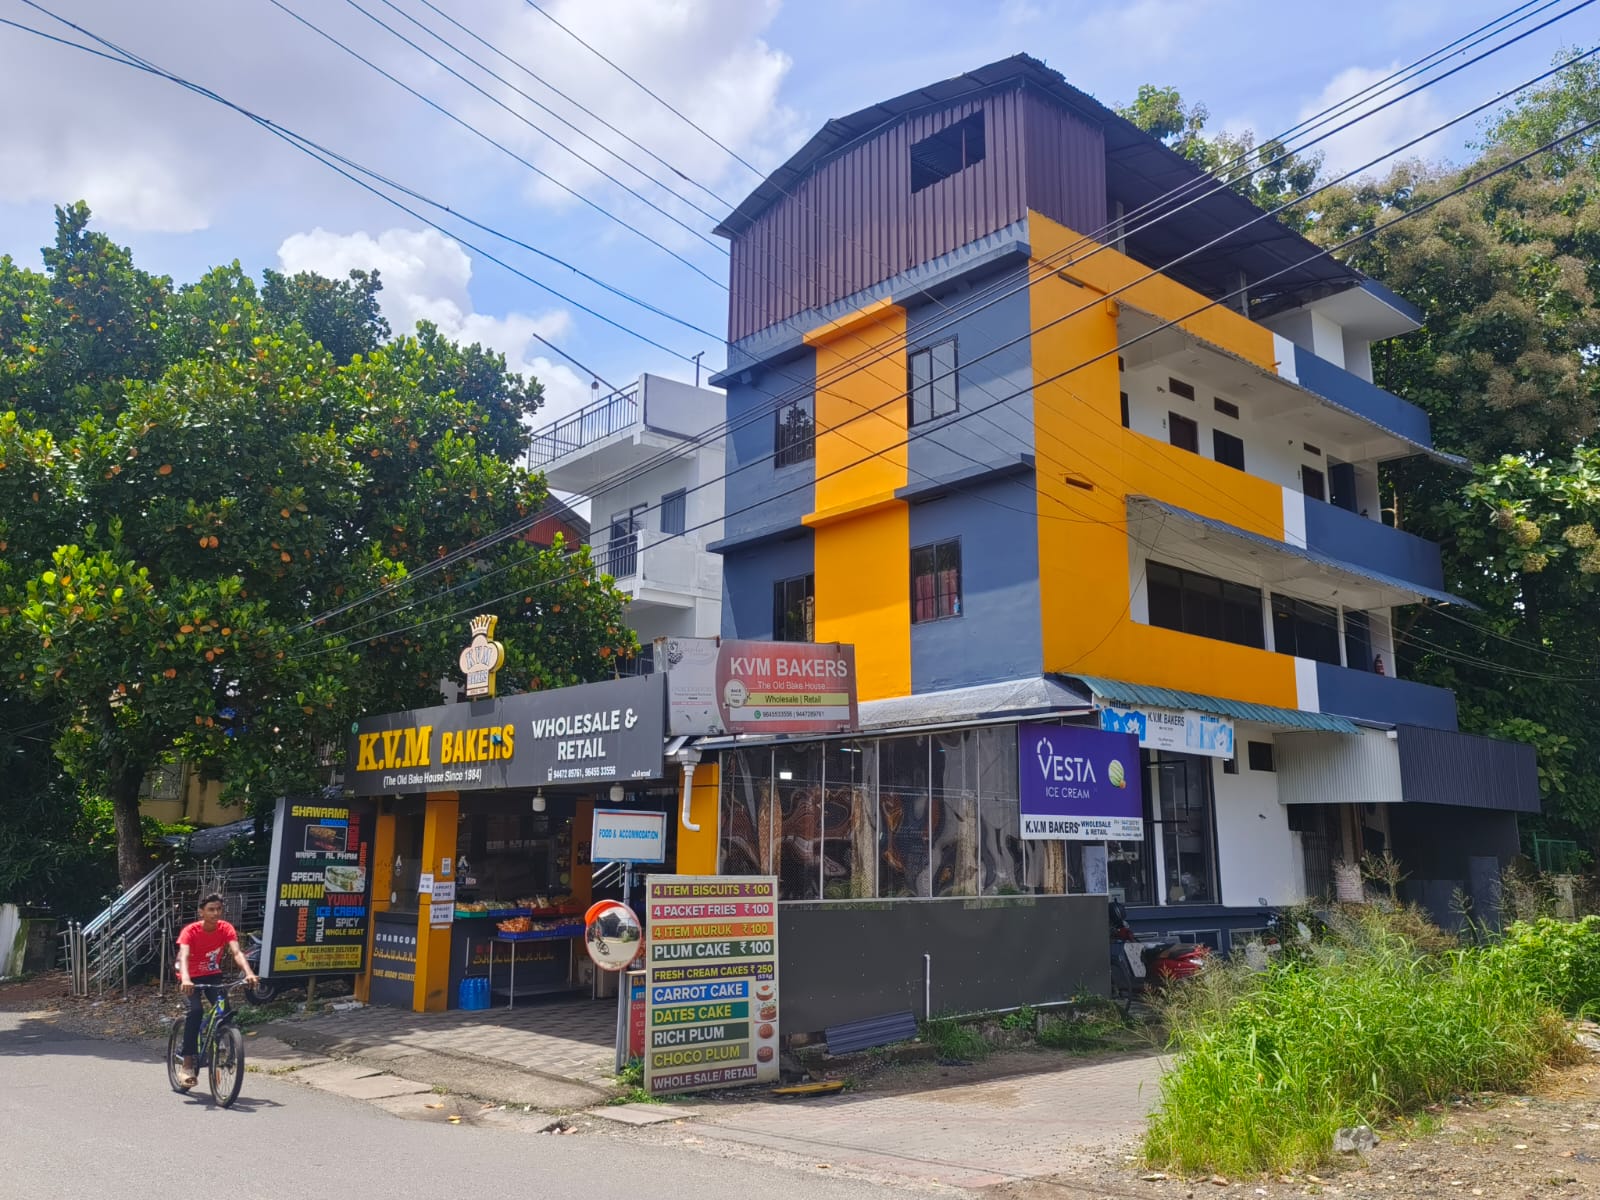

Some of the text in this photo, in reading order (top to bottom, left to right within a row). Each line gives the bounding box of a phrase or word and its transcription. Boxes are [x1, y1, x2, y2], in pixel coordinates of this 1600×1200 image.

[730, 657, 848, 677] KVM BAKERS
[757, 681, 826, 690] The Old Bake House
[764, 695, 822, 704] Wholesale Retail
[532, 708, 638, 738] WHOLESALE &
[1164, 714, 1184, 726] BAKERS
[356, 724, 515, 771] K.V.M BAKERS
[558, 737, 606, 760] RETAIL
[1037, 746, 1096, 783] VESTA
[397, 774, 408, 785] Old
[408, 773, 424, 784] Bake
[424, 772, 444, 783] House
[444, 770, 463, 782] Since
[464, 768, 482, 782] 1984)
[1046, 786, 1090, 798] ICE CREAM
[292, 806, 349, 818] SHAWARMA
[1026, 820, 1046, 832] K.V.M
[1081, 820, 1112, 828] WHOLESALE
[599, 829, 612, 838] FOOD
[291, 872, 326, 882] SPECIAL
[280, 884, 326, 899] BIRIYANI
[654, 886, 660, 896] 4
[664, 885, 689, 896] ITEM
[692, 884, 740, 895] BISCUITS
[753, 884, 770, 894] 100
[327, 894, 364, 906] YUMMY
[316, 906, 365, 917] ICE CREAM
[654, 906, 660, 916] 4
[664, 905, 705, 916] PACKET
[708, 904, 736, 915] FRIES
[752, 904, 769, 914] 100
[296, 908, 308, 942] KABAB
[315, 916, 326, 942] ROLLS
[336, 918, 360, 927] SPICY
[654, 928, 660, 937] 4
[664, 926, 690, 937] ITEM
[694, 925, 732, 936] MURUK
[750, 924, 768, 934] 100
[654, 945, 692, 959] PLUM
[696, 943, 730, 956] CAKE
[750, 941, 770, 954] 100
[654, 970, 684, 980] FRESH
[687, 968, 718, 978] CREAM
[720, 966, 748, 976] CAKES
[757, 964, 772, 973] 250
[654, 984, 742, 1002] CARROT CAKE
[654, 1005, 732, 1023] DATES CAKE
[654, 1026, 724, 1045] RICH PLUM
[654, 1046, 740, 1066] CHOCO PLUM
[654, 1066, 756, 1089] WHOLE SALE/ RETAIL
